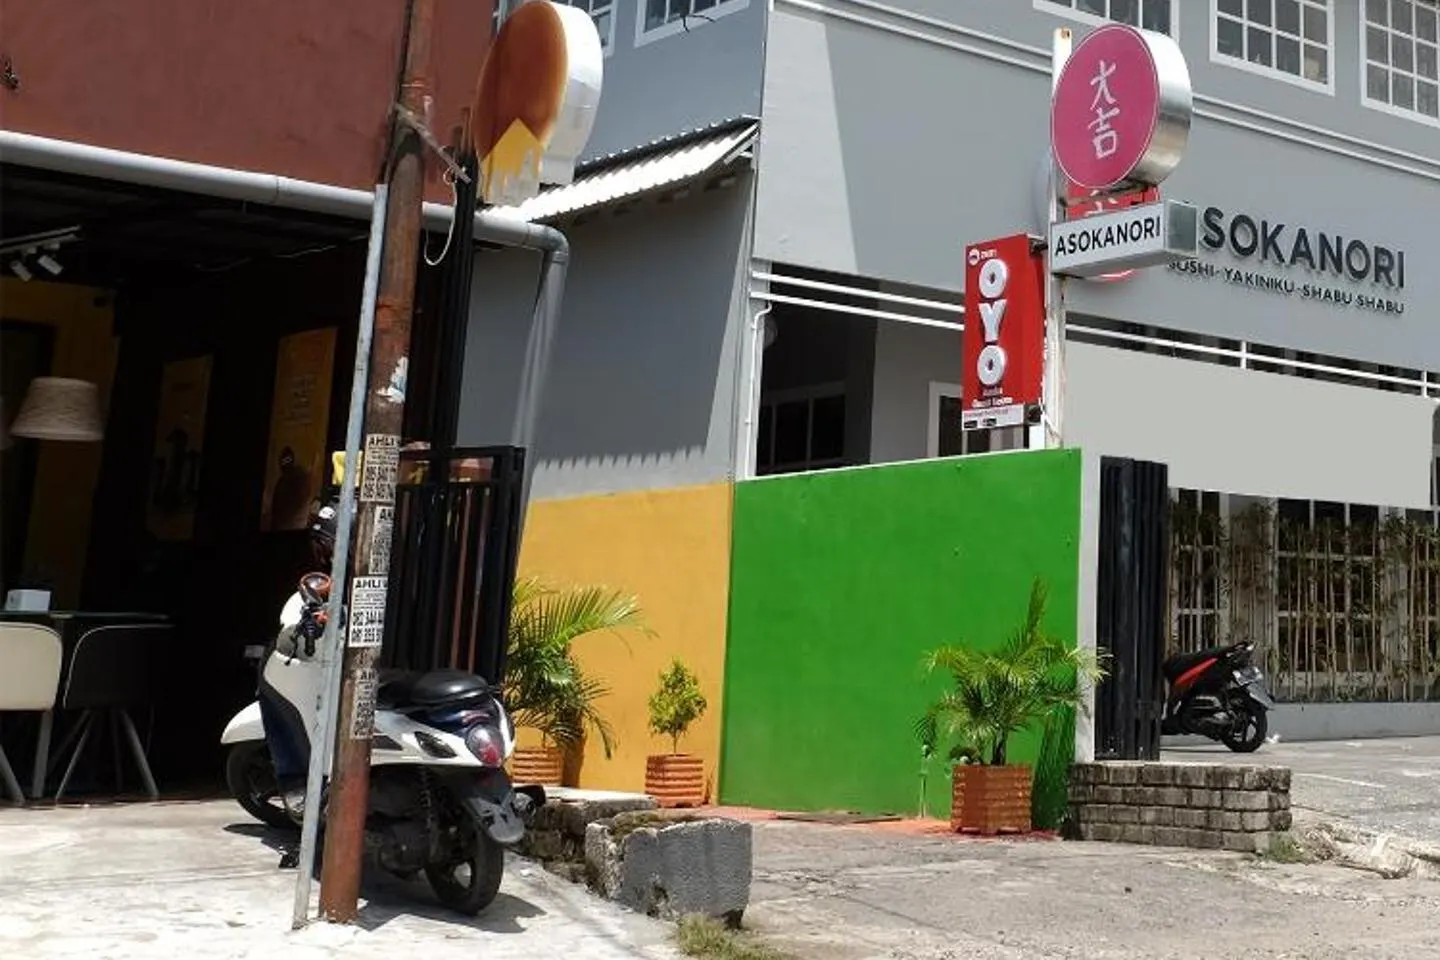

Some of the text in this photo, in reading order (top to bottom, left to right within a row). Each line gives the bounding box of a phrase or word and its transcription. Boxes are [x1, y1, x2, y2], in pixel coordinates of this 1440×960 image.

[1055, 216, 1161, 257] ASOKANORI
[1202, 206, 1405, 289] SOKANORI
[977, 258, 1008, 386] OYO
[1303, 284, 1353, 304] SHABU
[1356, 294, 1404, 314] SHABU
